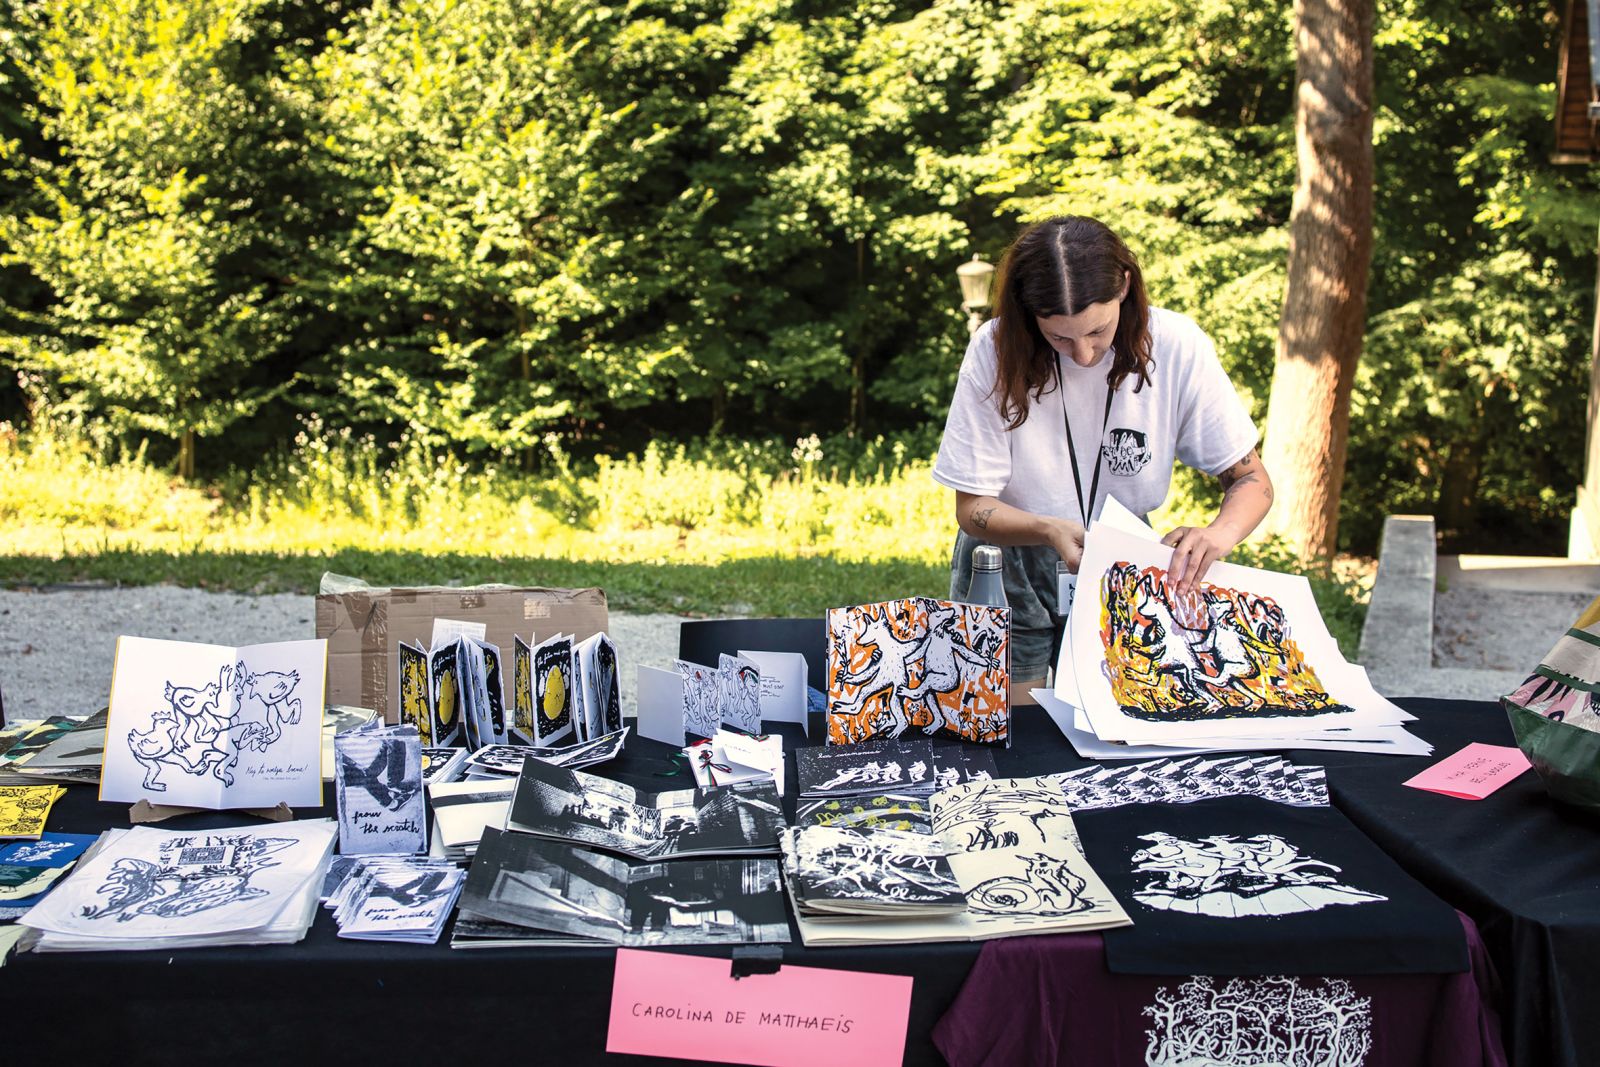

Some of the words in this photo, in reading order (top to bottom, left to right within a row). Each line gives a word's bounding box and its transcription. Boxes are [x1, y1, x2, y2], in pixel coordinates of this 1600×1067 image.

[360, 822, 379, 834] the
[382, 818, 420, 834] scratch
[725, 1011, 746, 1025] DE
